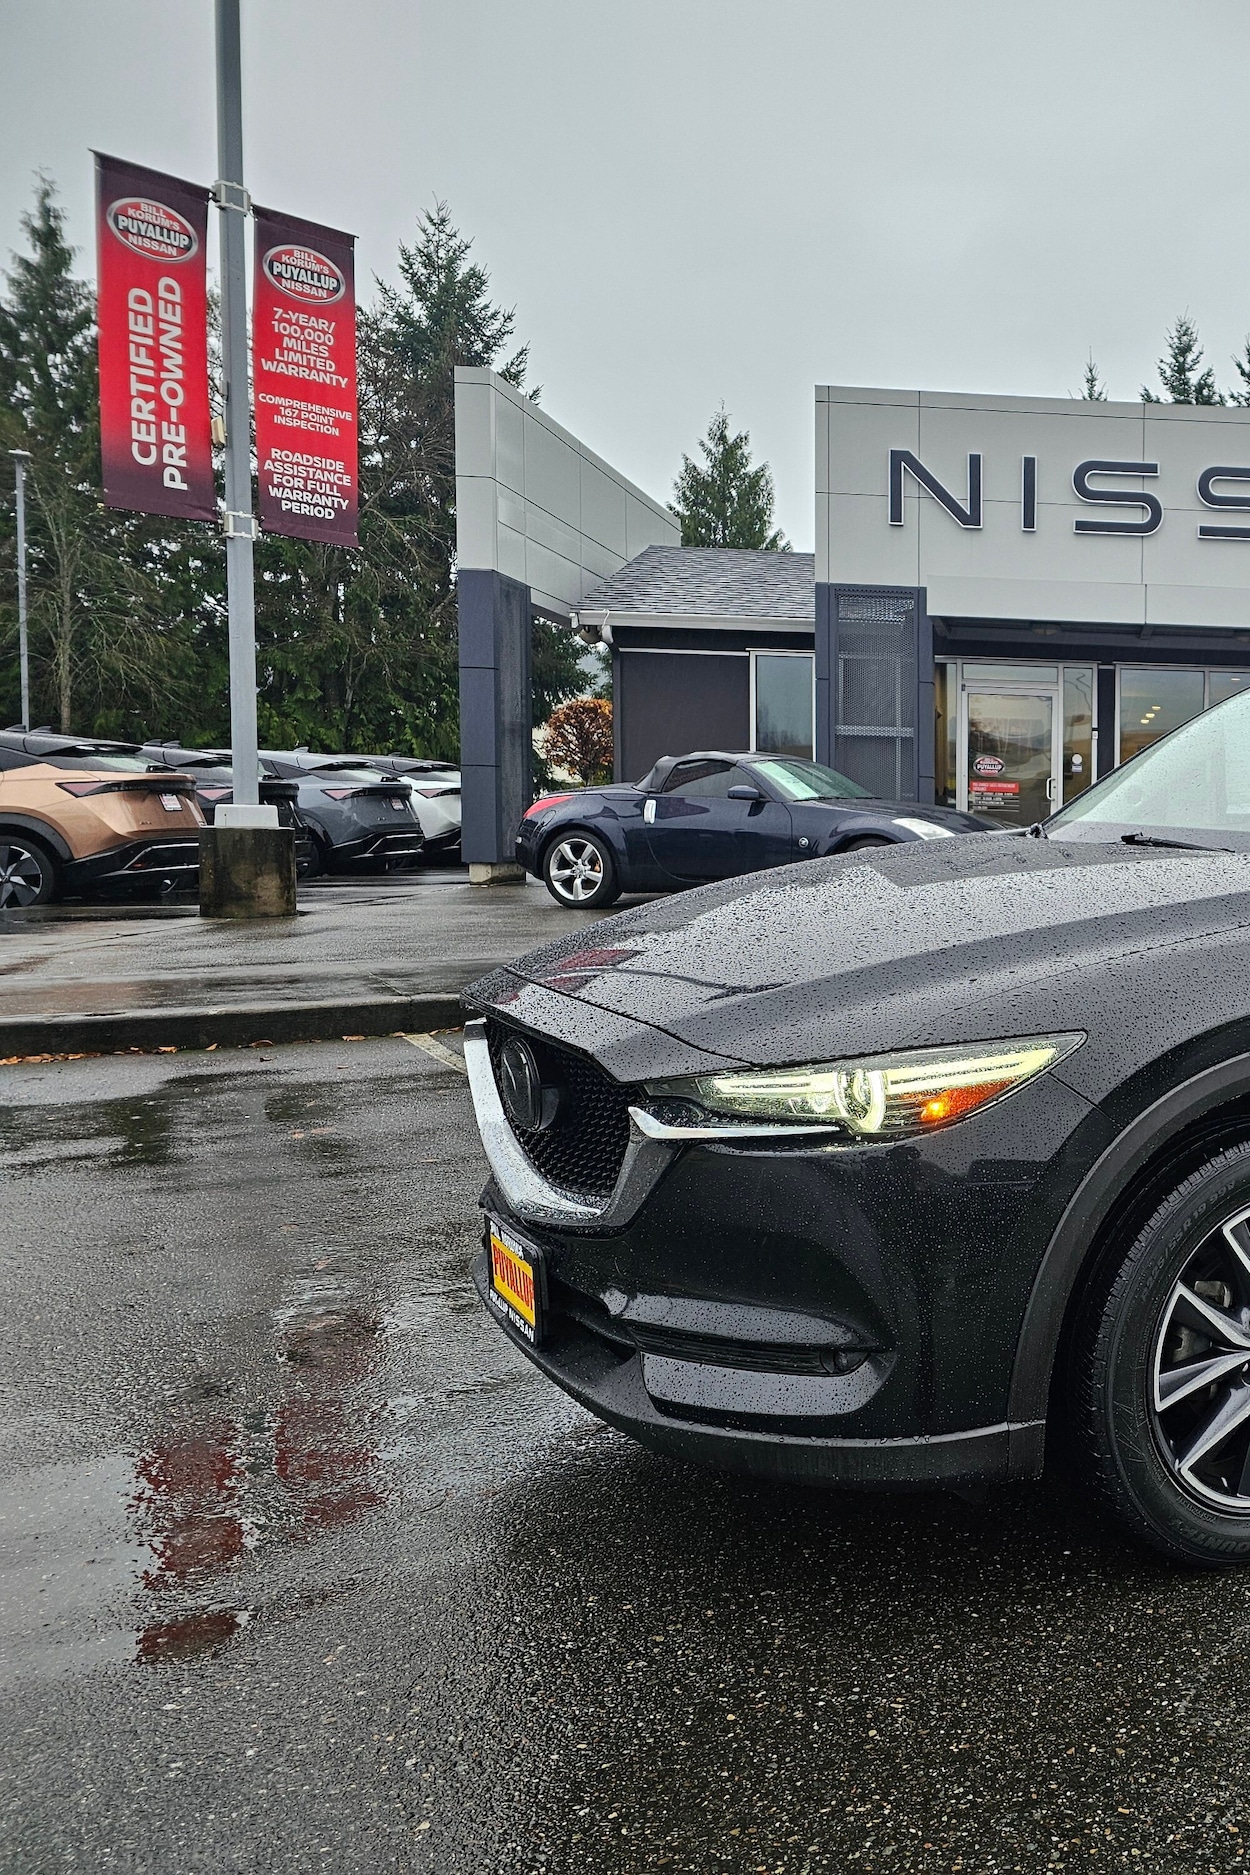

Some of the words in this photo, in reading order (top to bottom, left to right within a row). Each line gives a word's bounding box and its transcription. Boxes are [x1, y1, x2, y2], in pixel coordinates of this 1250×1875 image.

[127, 207, 180, 231] KORUM'S
[140, 203, 167, 218] BILL
[117, 214, 190, 248] PUYALLUP
[127, 233, 177, 256] NISSAN
[293, 249, 317, 263] BILL
[273, 261, 338, 291] PUYALLUP
[281, 254, 330, 274] KORUM'S
[281, 278, 327, 298] NISSAN
[271, 320, 334, 346] 100,000
[272, 307, 336, 334] 7-YEAR/
[274, 347, 336, 372] LIMITED
[282, 336, 329, 358] MILES
[128, 287, 157, 466] CERTIFIED
[158, 276, 189, 491] PRE-OWNED
[260, 358, 348, 388] WARRANTY
[258, 391, 353, 421] COMPREHENSIVE
[279, 406, 299, 418] 167
[301, 411, 335, 426] POINT
[273, 415, 339, 437] INSPECTION
[263, 459, 352, 486] ASSISTANCE
[271, 447, 345, 473] ROADSIDE
[268, 484, 349, 510] WARRANTY
[273, 473, 305, 490] FOR
[307, 479, 341, 497] FULL
[281, 500, 335, 520] PERIOD
[508, 1307, 535, 1343] NISSAN
